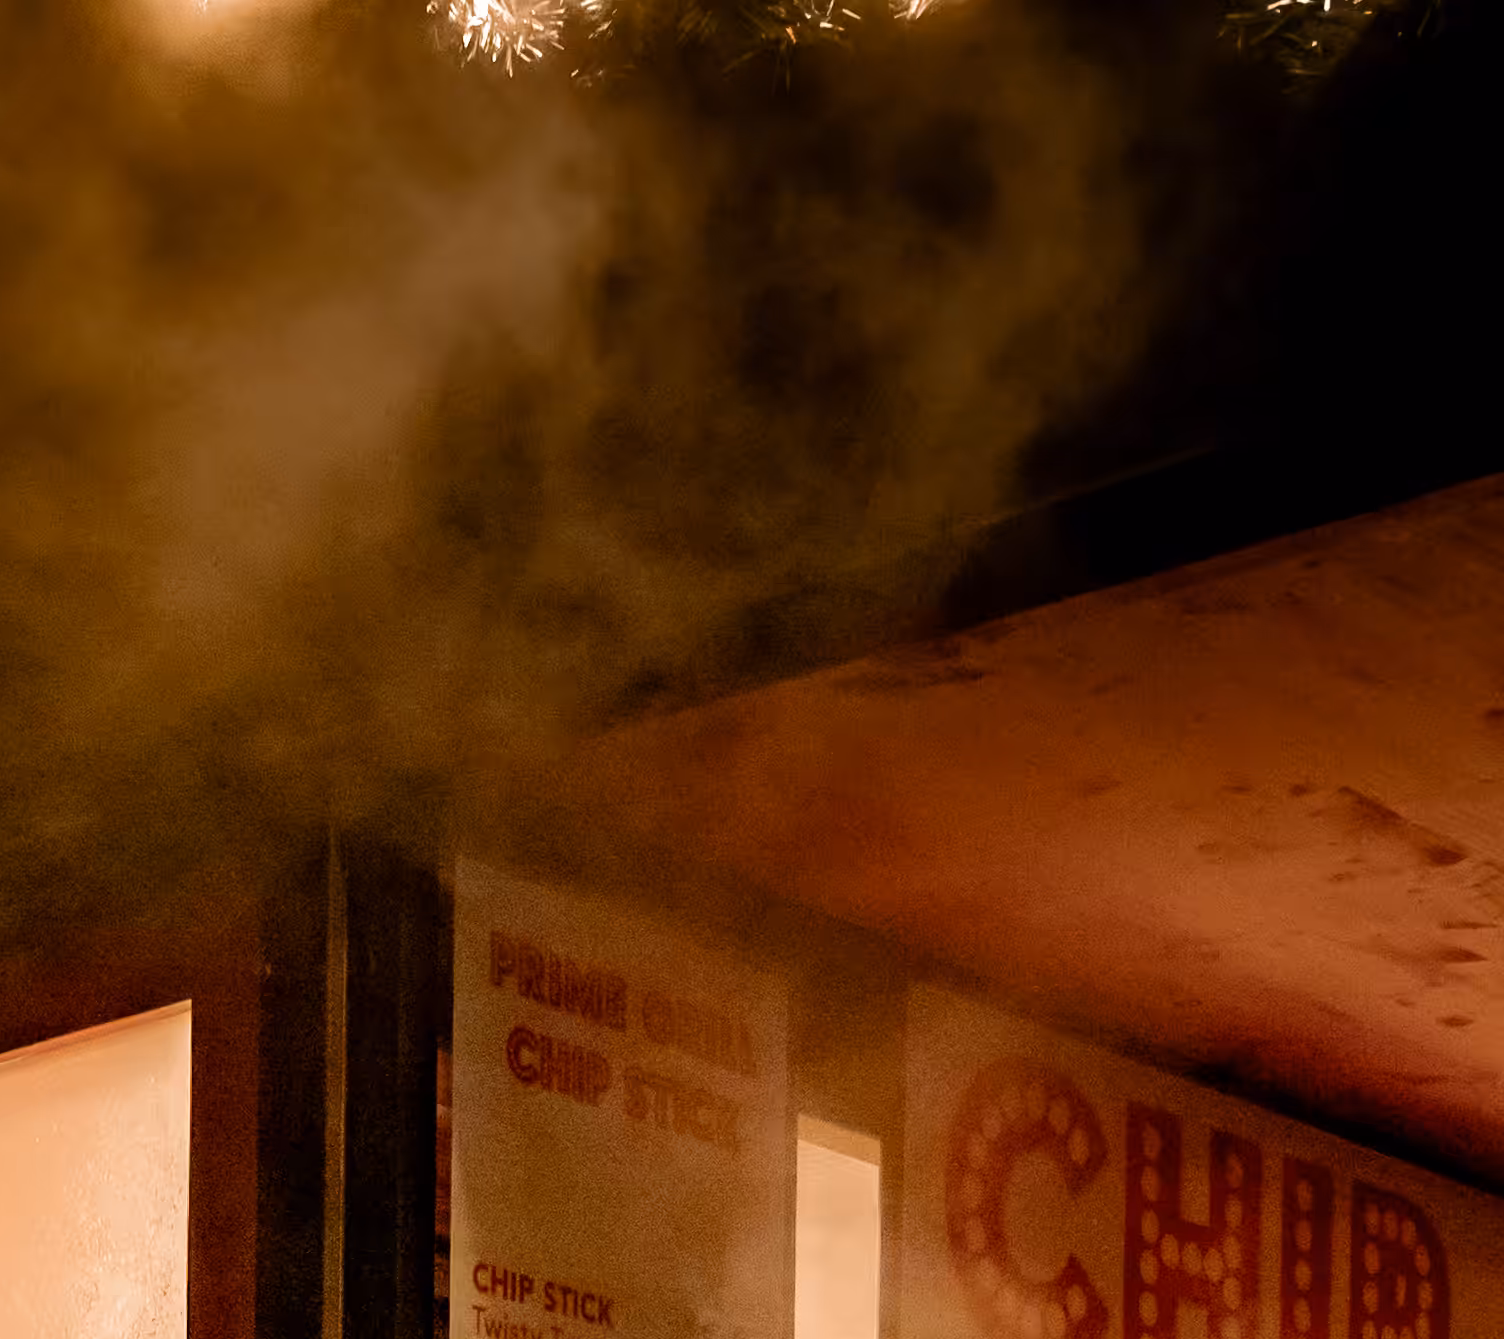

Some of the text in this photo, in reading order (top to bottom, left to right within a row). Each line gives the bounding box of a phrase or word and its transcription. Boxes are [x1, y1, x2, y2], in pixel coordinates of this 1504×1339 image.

[506, 1026, 611, 1108] CHIP
[472, 1263, 613, 1327] CHIP STICK
